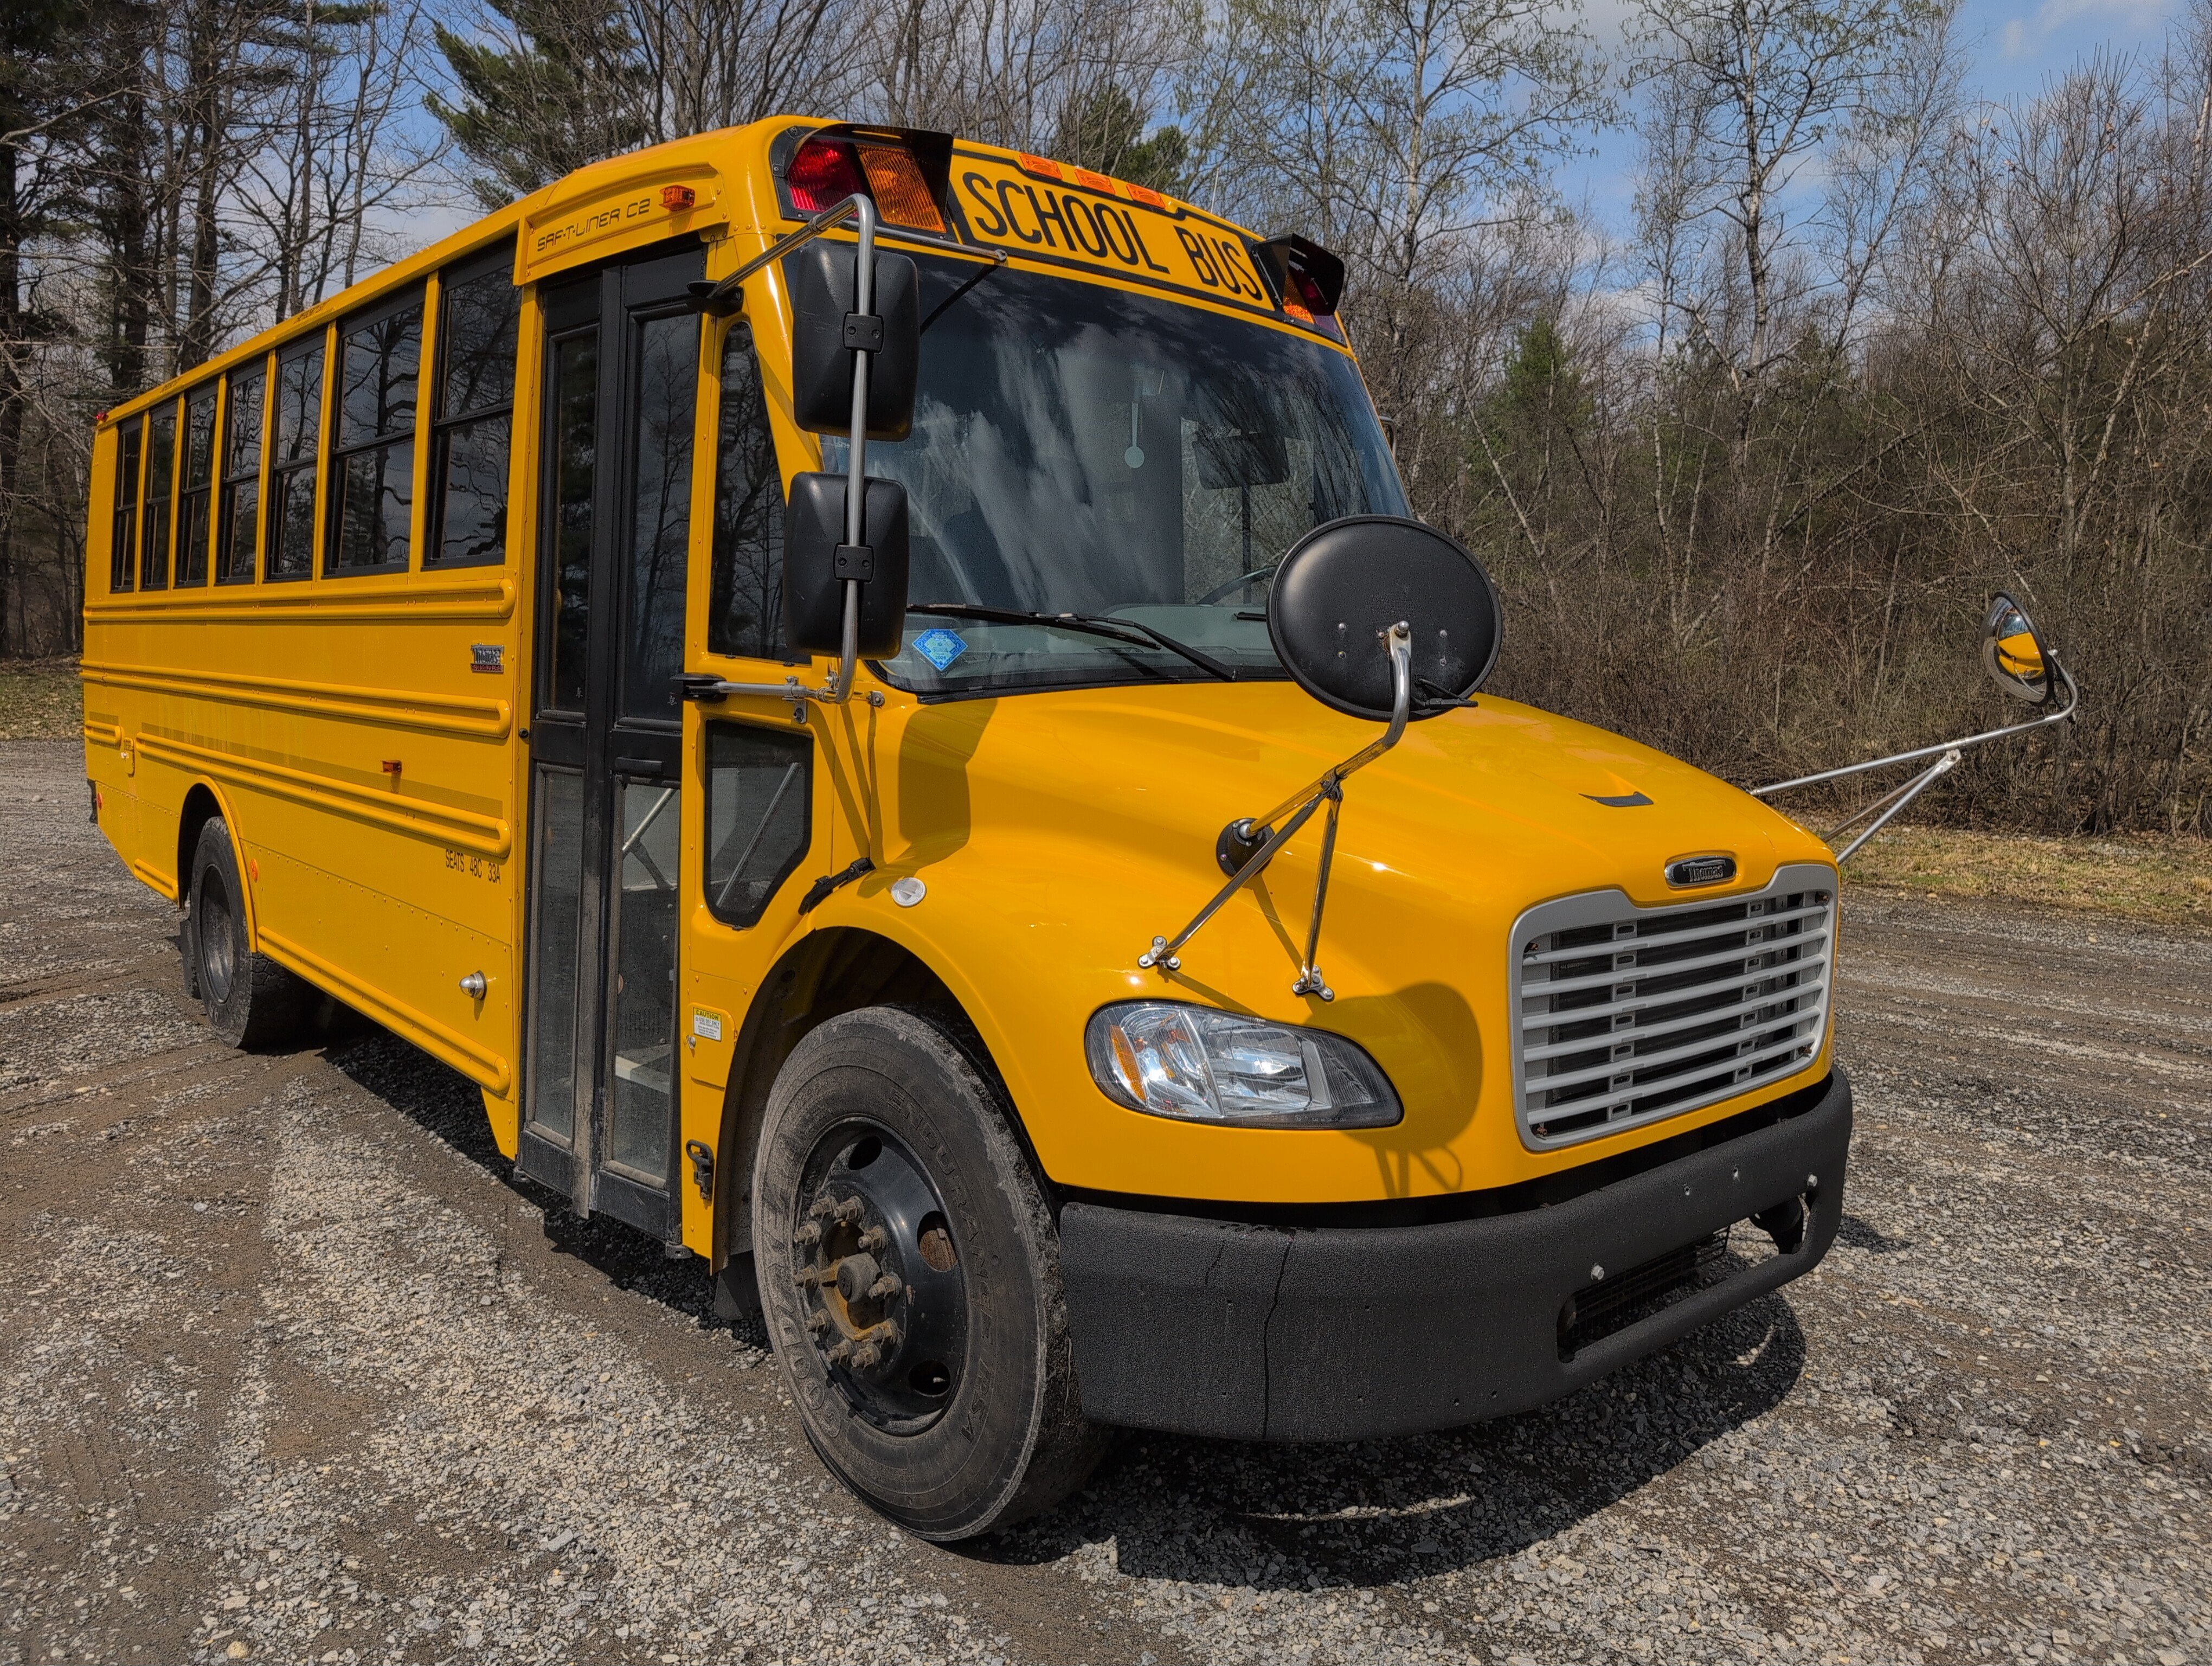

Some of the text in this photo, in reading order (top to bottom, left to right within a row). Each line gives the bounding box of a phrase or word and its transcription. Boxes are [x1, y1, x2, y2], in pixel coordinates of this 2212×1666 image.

[626, 198, 651, 218] C2
[962, 171, 1263, 301] SCHOOL BUS
[446, 849, 501, 885] SEATS 48C 33A
[1682, 859, 1726, 882] Thomas
[696, 1009, 719, 1021] CAUTION
